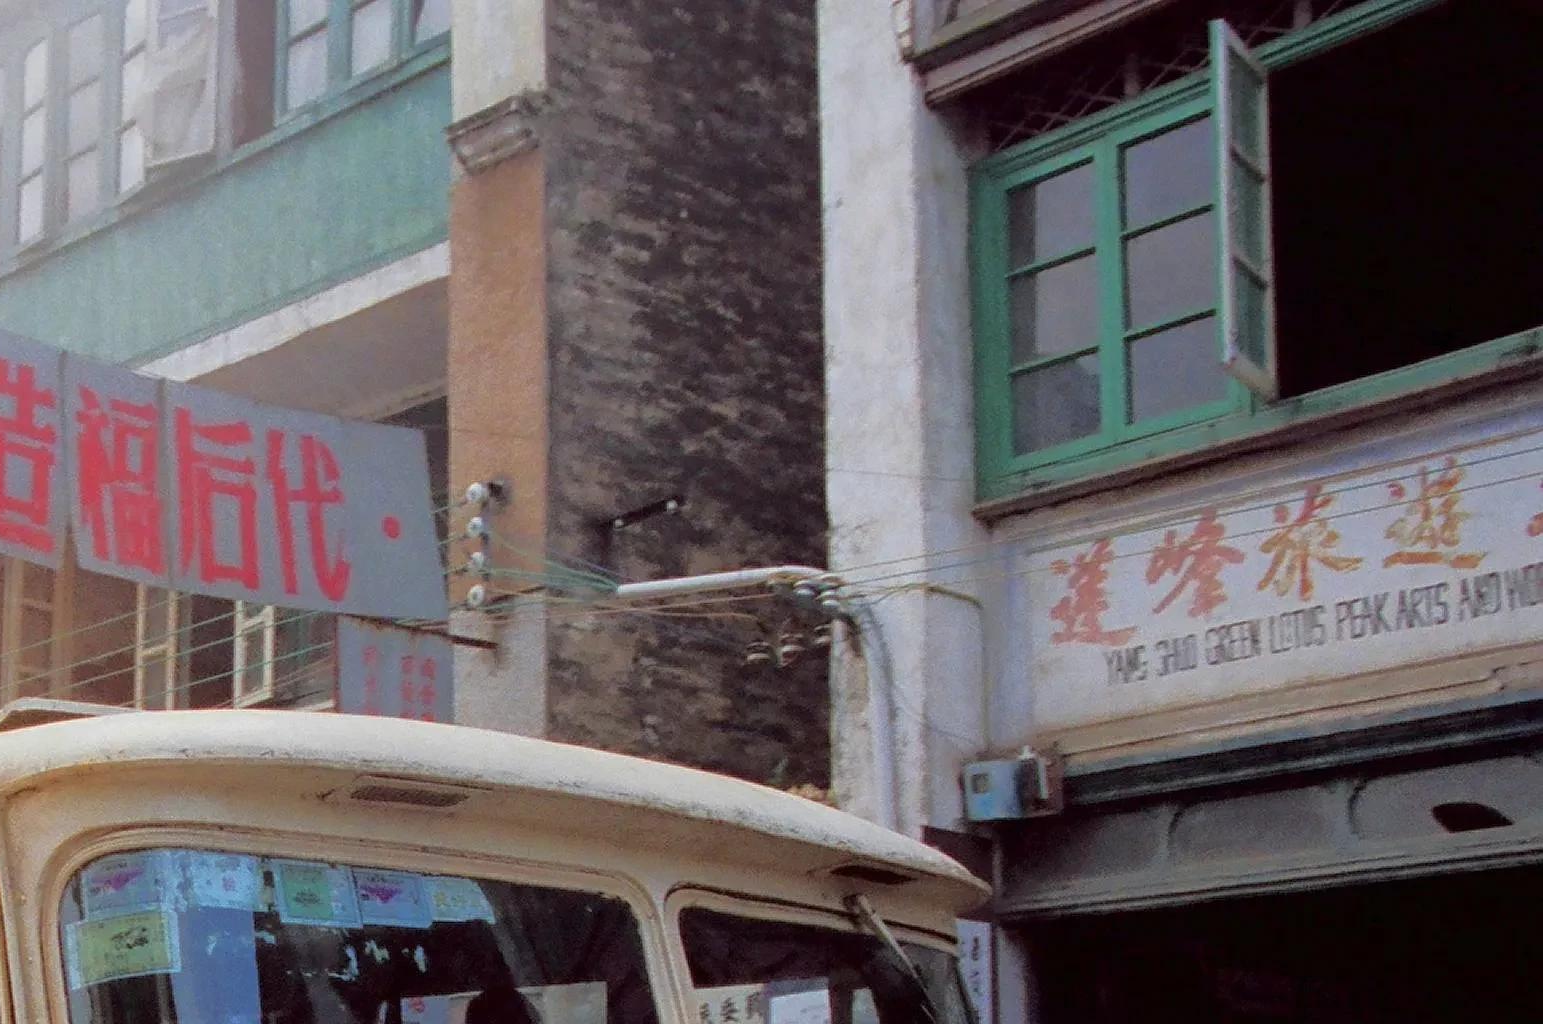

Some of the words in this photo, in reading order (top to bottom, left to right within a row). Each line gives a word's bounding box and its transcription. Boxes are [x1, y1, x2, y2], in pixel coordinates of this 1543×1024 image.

[1205, 619, 1261, 665] GREEN
[1270, 604, 1326, 653] LOTUS
[1335, 591, 1393, 641] PEAK
[1395, 582, 1449, 630] ARTS
